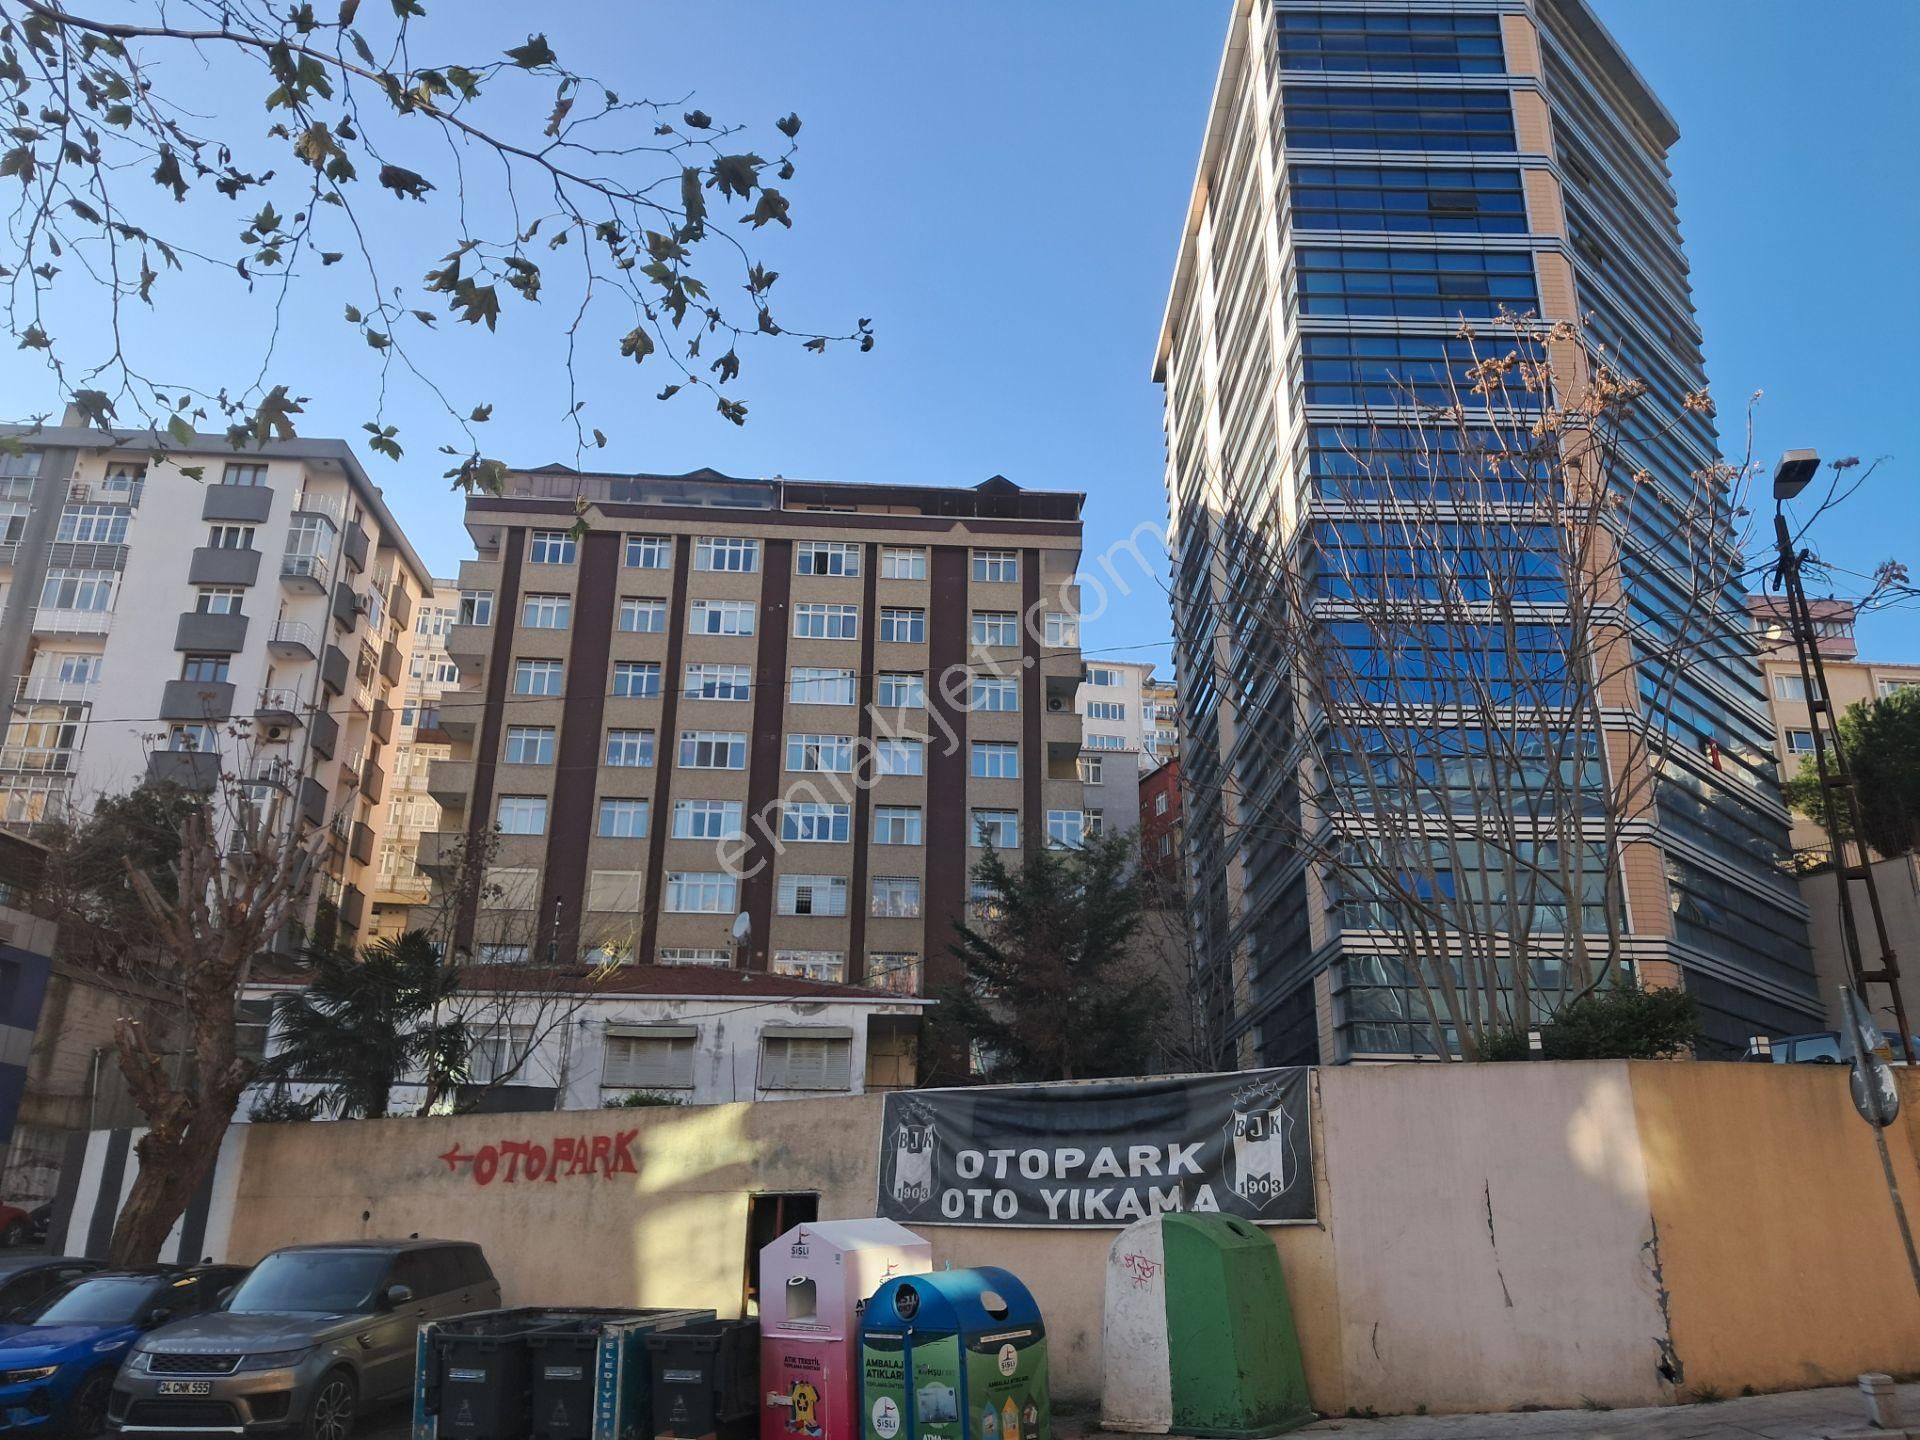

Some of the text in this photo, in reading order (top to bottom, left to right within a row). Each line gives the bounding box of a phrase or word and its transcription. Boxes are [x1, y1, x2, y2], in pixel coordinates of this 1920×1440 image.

[1234, 1115, 1281, 1137] BJK
[899, 1128, 933, 1149] BJK
[473, 1128, 639, 1185] OTOPARK
[956, 1142, 1206, 1179] OTOPARK
[897, 1186, 930, 1199] 1903
[1238, 1179, 1282, 1195] 1903
[941, 1183, 1221, 1220] OTO YIKAMA
[866, 1359, 904, 1369] AMBALAJ
[160, 1382, 209, 1393] 34 CNK 555
